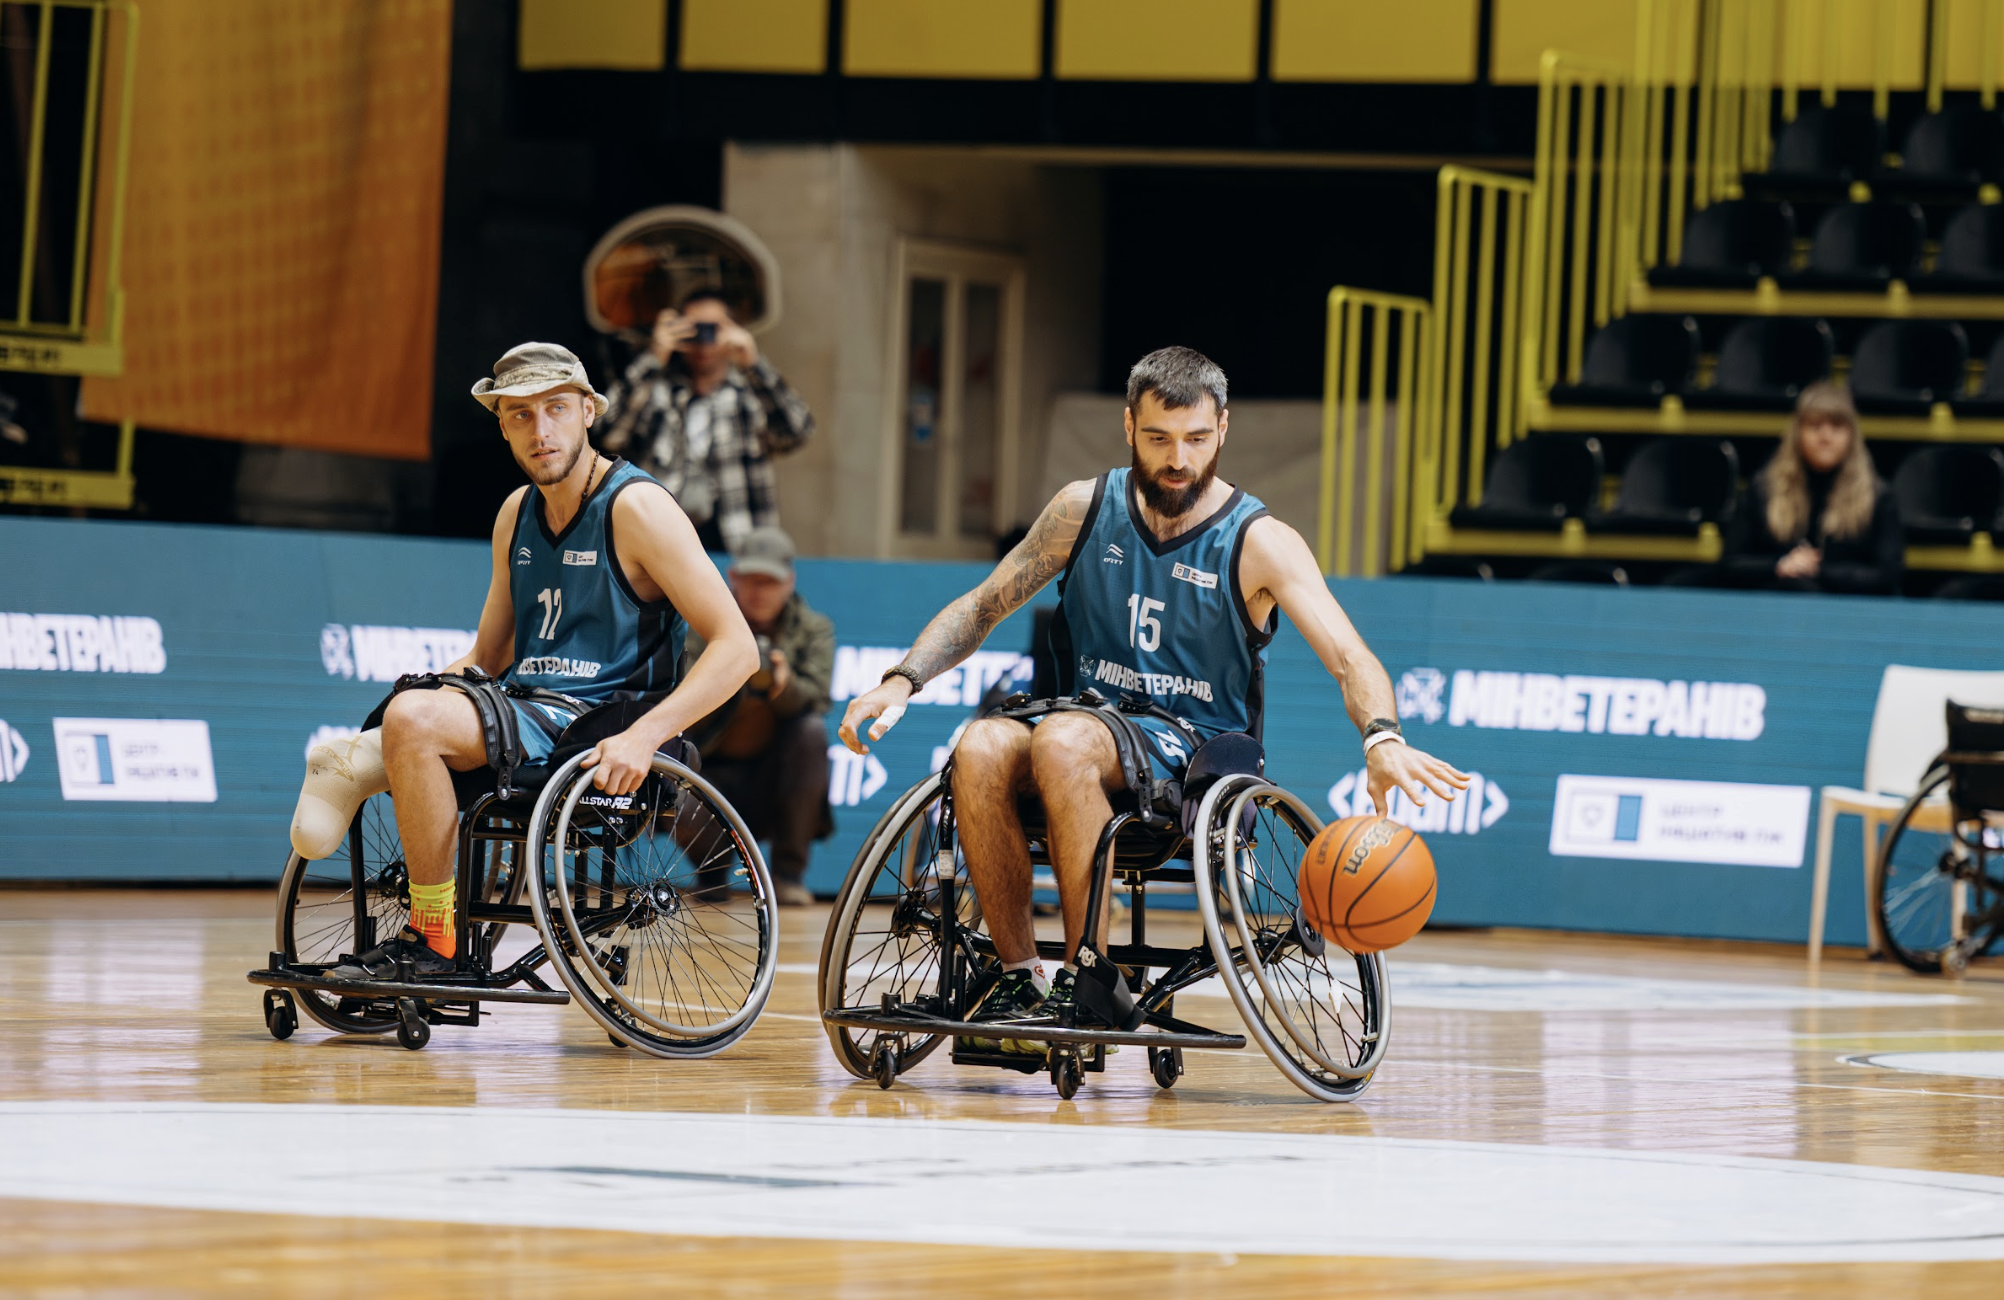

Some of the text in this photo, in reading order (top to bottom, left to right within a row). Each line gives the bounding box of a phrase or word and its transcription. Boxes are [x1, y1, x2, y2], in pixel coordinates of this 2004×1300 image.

[537, 588, 562, 640] 12
[1127, 593, 1166, 653] 15
[1094, 658, 1214, 703] МІНВЕТЕРАНІВ
[1447, 669, 1767, 742] МІНВЕТЕРАНІВ
